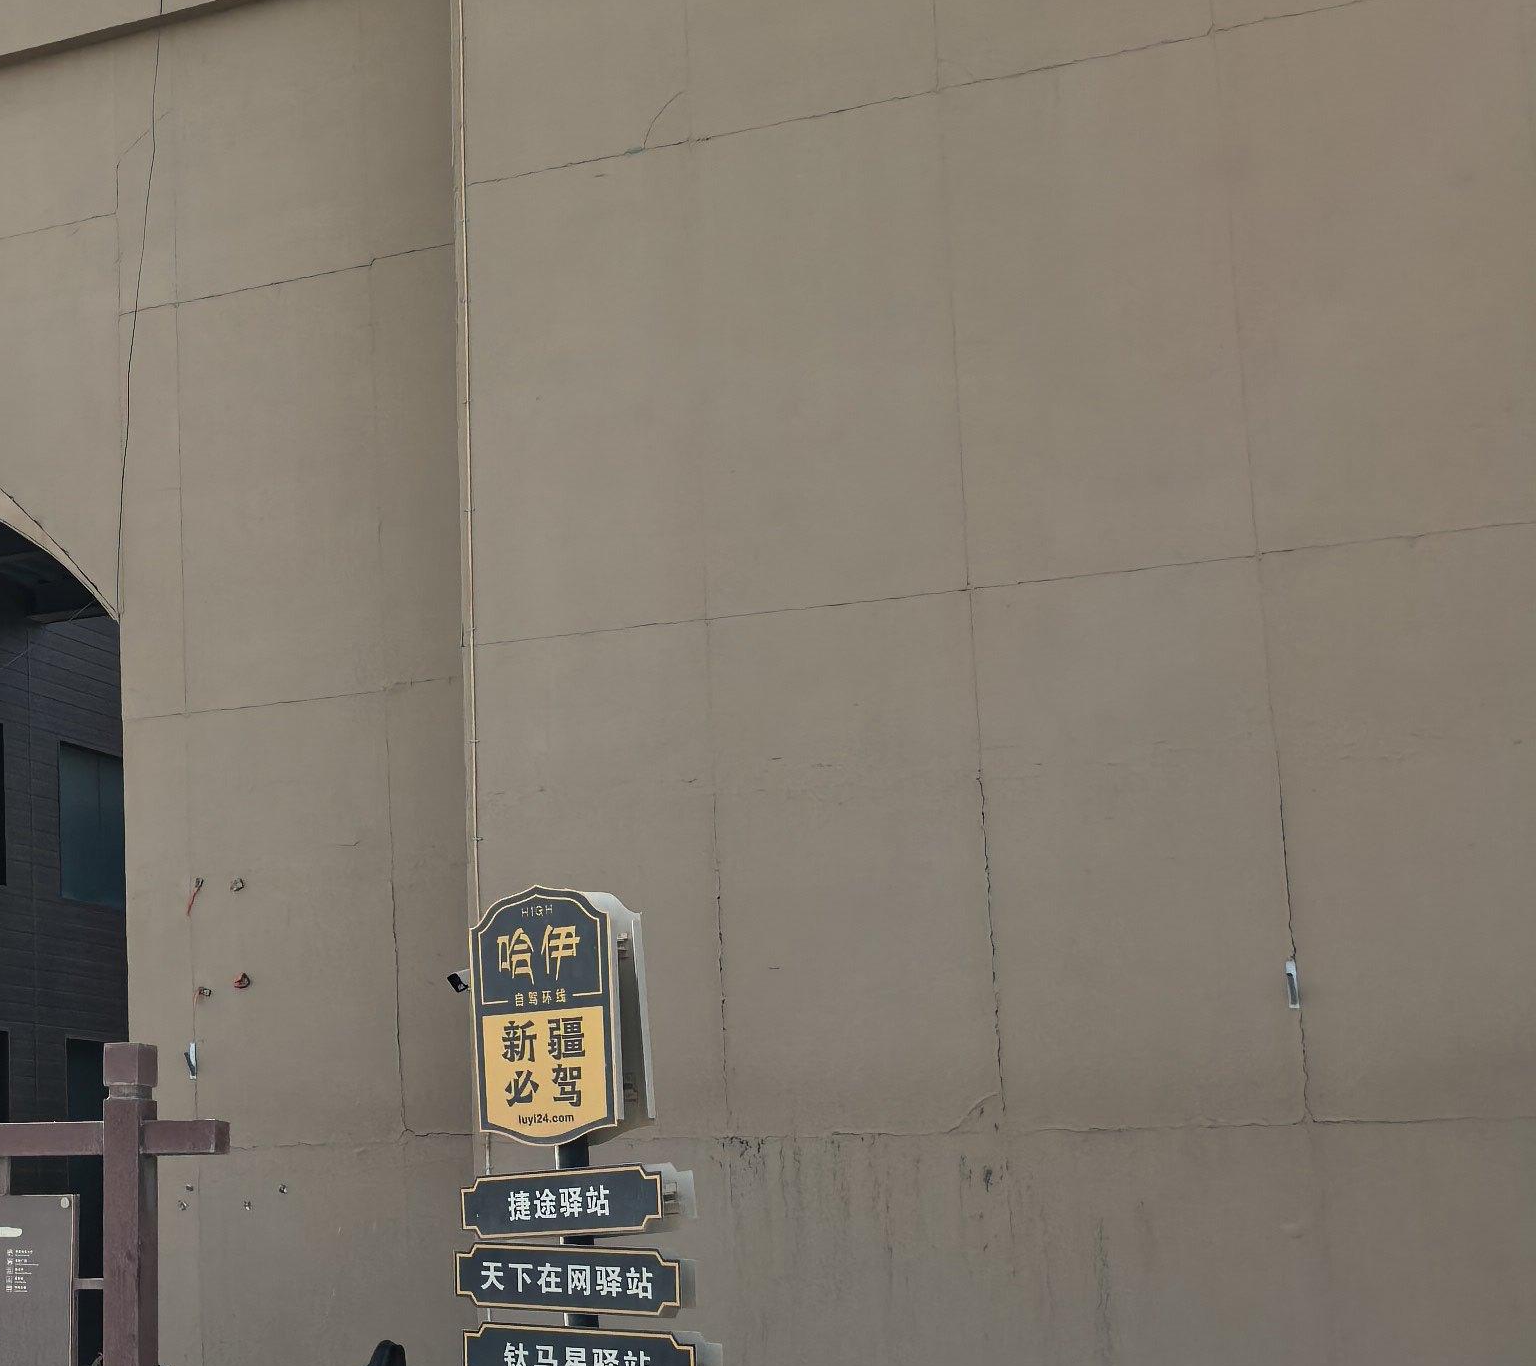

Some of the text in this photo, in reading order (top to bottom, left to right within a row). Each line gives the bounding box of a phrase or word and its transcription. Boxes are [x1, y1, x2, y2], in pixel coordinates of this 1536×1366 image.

[497, 924, 581, 985] 哈伊
[515, 988, 566, 1007] 自驾环线
[502, 1016, 586, 1063] 新疆
[505, 1064, 582, 1108] 必驾
[507, 1185, 611, 1222] 捷途驿站
[481, 1261, 654, 1300] 天下在网驿站
